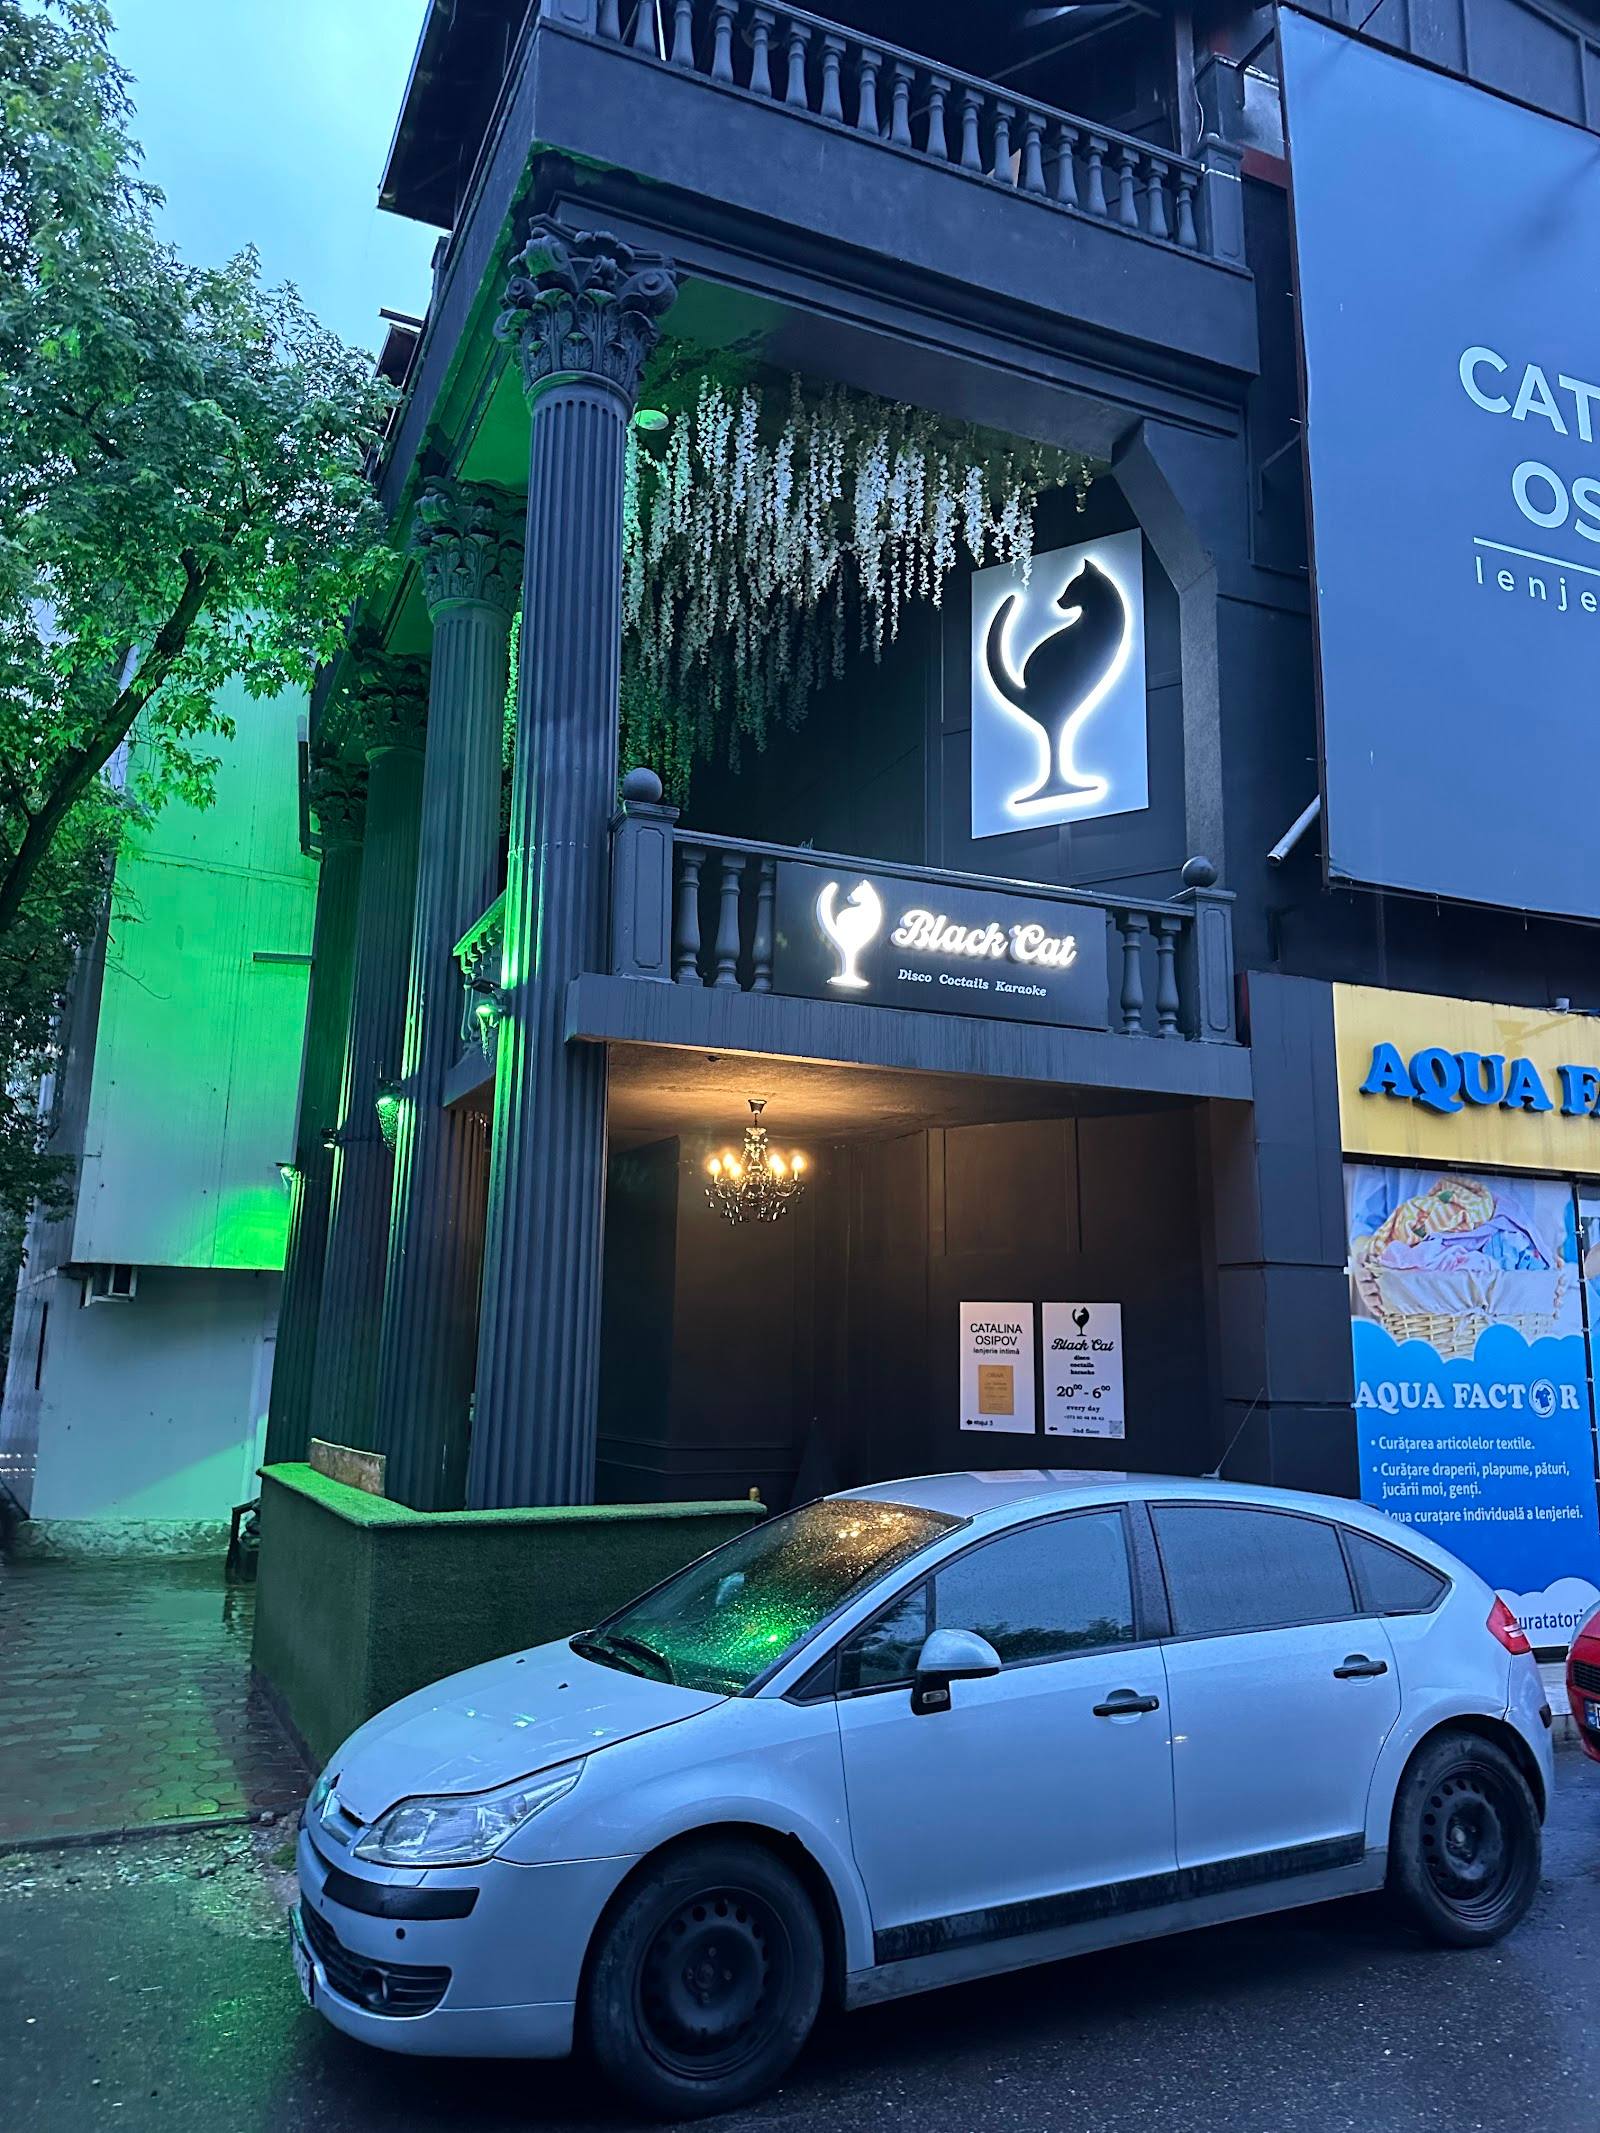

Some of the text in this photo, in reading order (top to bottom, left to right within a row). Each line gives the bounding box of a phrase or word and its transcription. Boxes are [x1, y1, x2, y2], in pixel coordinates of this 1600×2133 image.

[1459, 346, 1600, 443] CAT
[1475, 556, 1598, 612] lenje
[891, 909, 1077, 967] Black Cat
[898, 969, 1047, 997] Disco Coctails Karaoke
[1359, 1042, 1600, 1117] AQUA F
[970, 1323, 1023, 1334] CATALINA
[975, 1335, 1018, 1346] OSIPOV
[1051, 1338, 1115, 1351] Black Cat
[1351, 1381, 1445, 1415] AQUA
[1066, 1405, 1100, 1413] every day
[1379, 1436, 1535, 1453] Curățarea articolelor textile.
[1381, 1461, 1570, 1479] Curățare draperii, plapume, pături,
[1382, 1481, 1482, 1499] jucării moi, genți.
[1463, 1506, 1525, 1521] individuală
[1526, 1509, 1533, 1520] a
[1535, 1505, 1584, 1521] lenjeriei.
